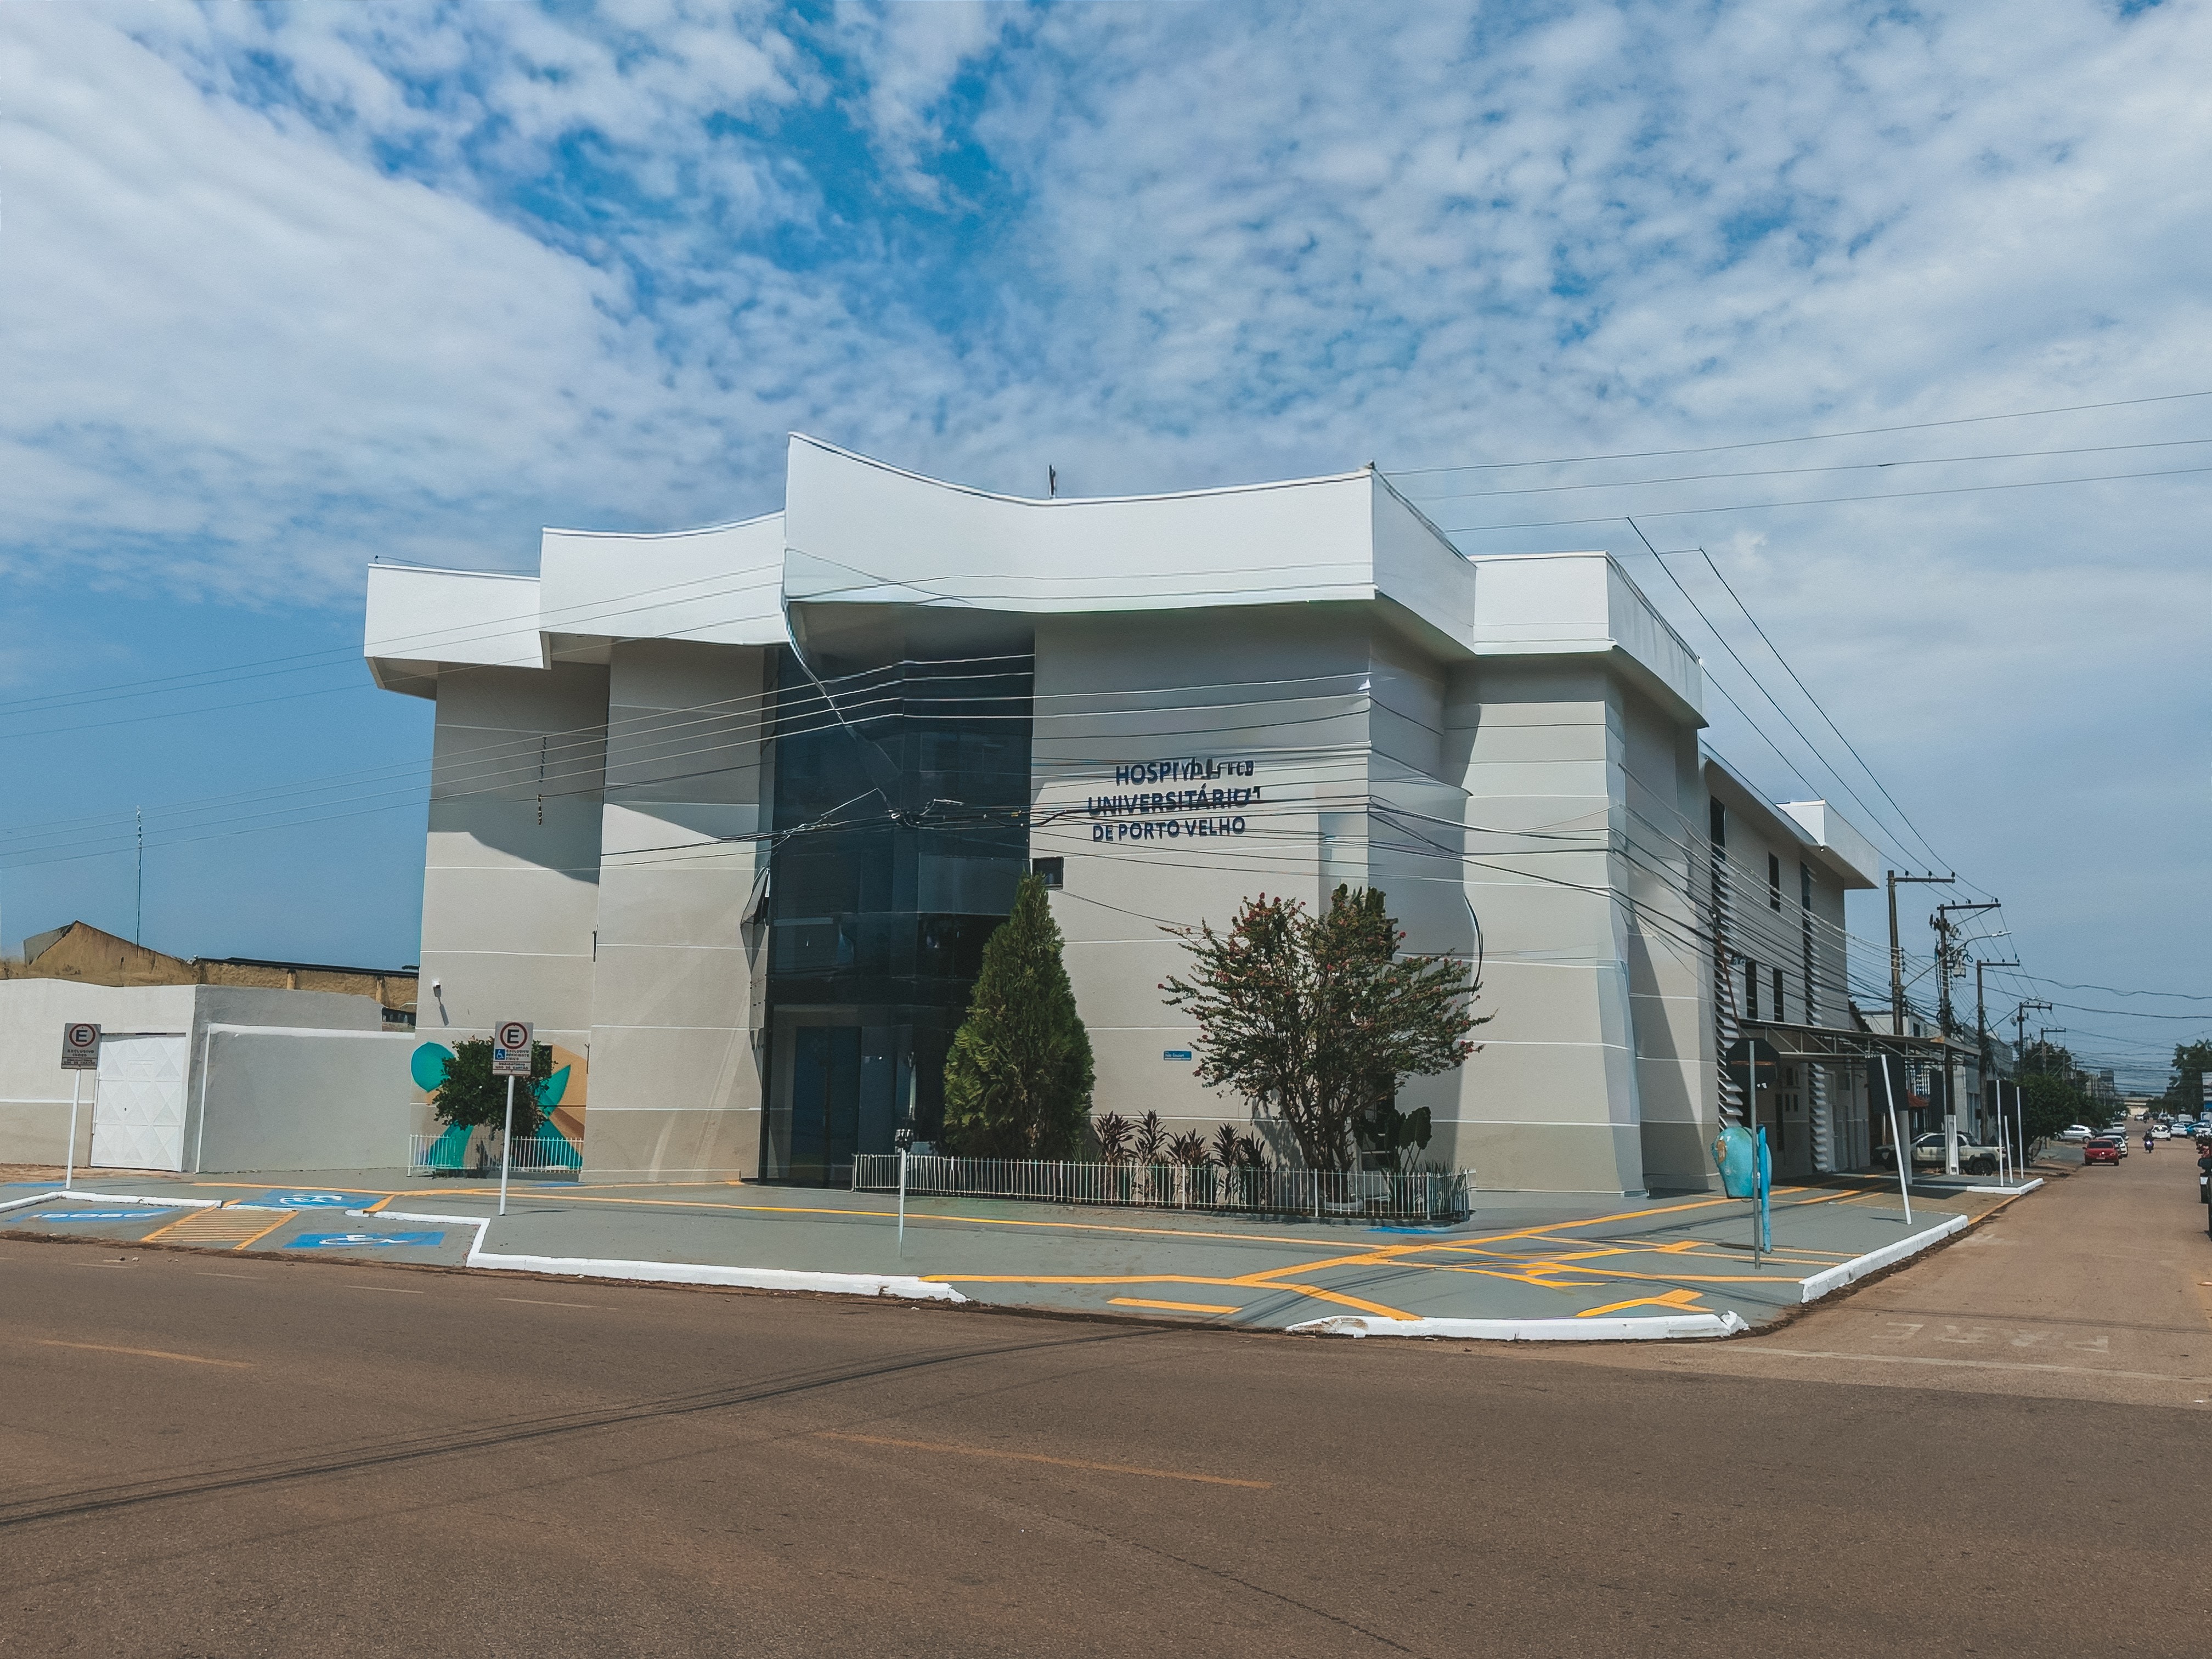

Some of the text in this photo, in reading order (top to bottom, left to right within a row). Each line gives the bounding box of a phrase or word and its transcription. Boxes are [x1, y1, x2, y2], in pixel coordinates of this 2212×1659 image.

[1092, 816, 1246, 842] DE PORTO VELHO
[76, 1029, 88, 1042] E
[507, 1029, 520, 1043] E
